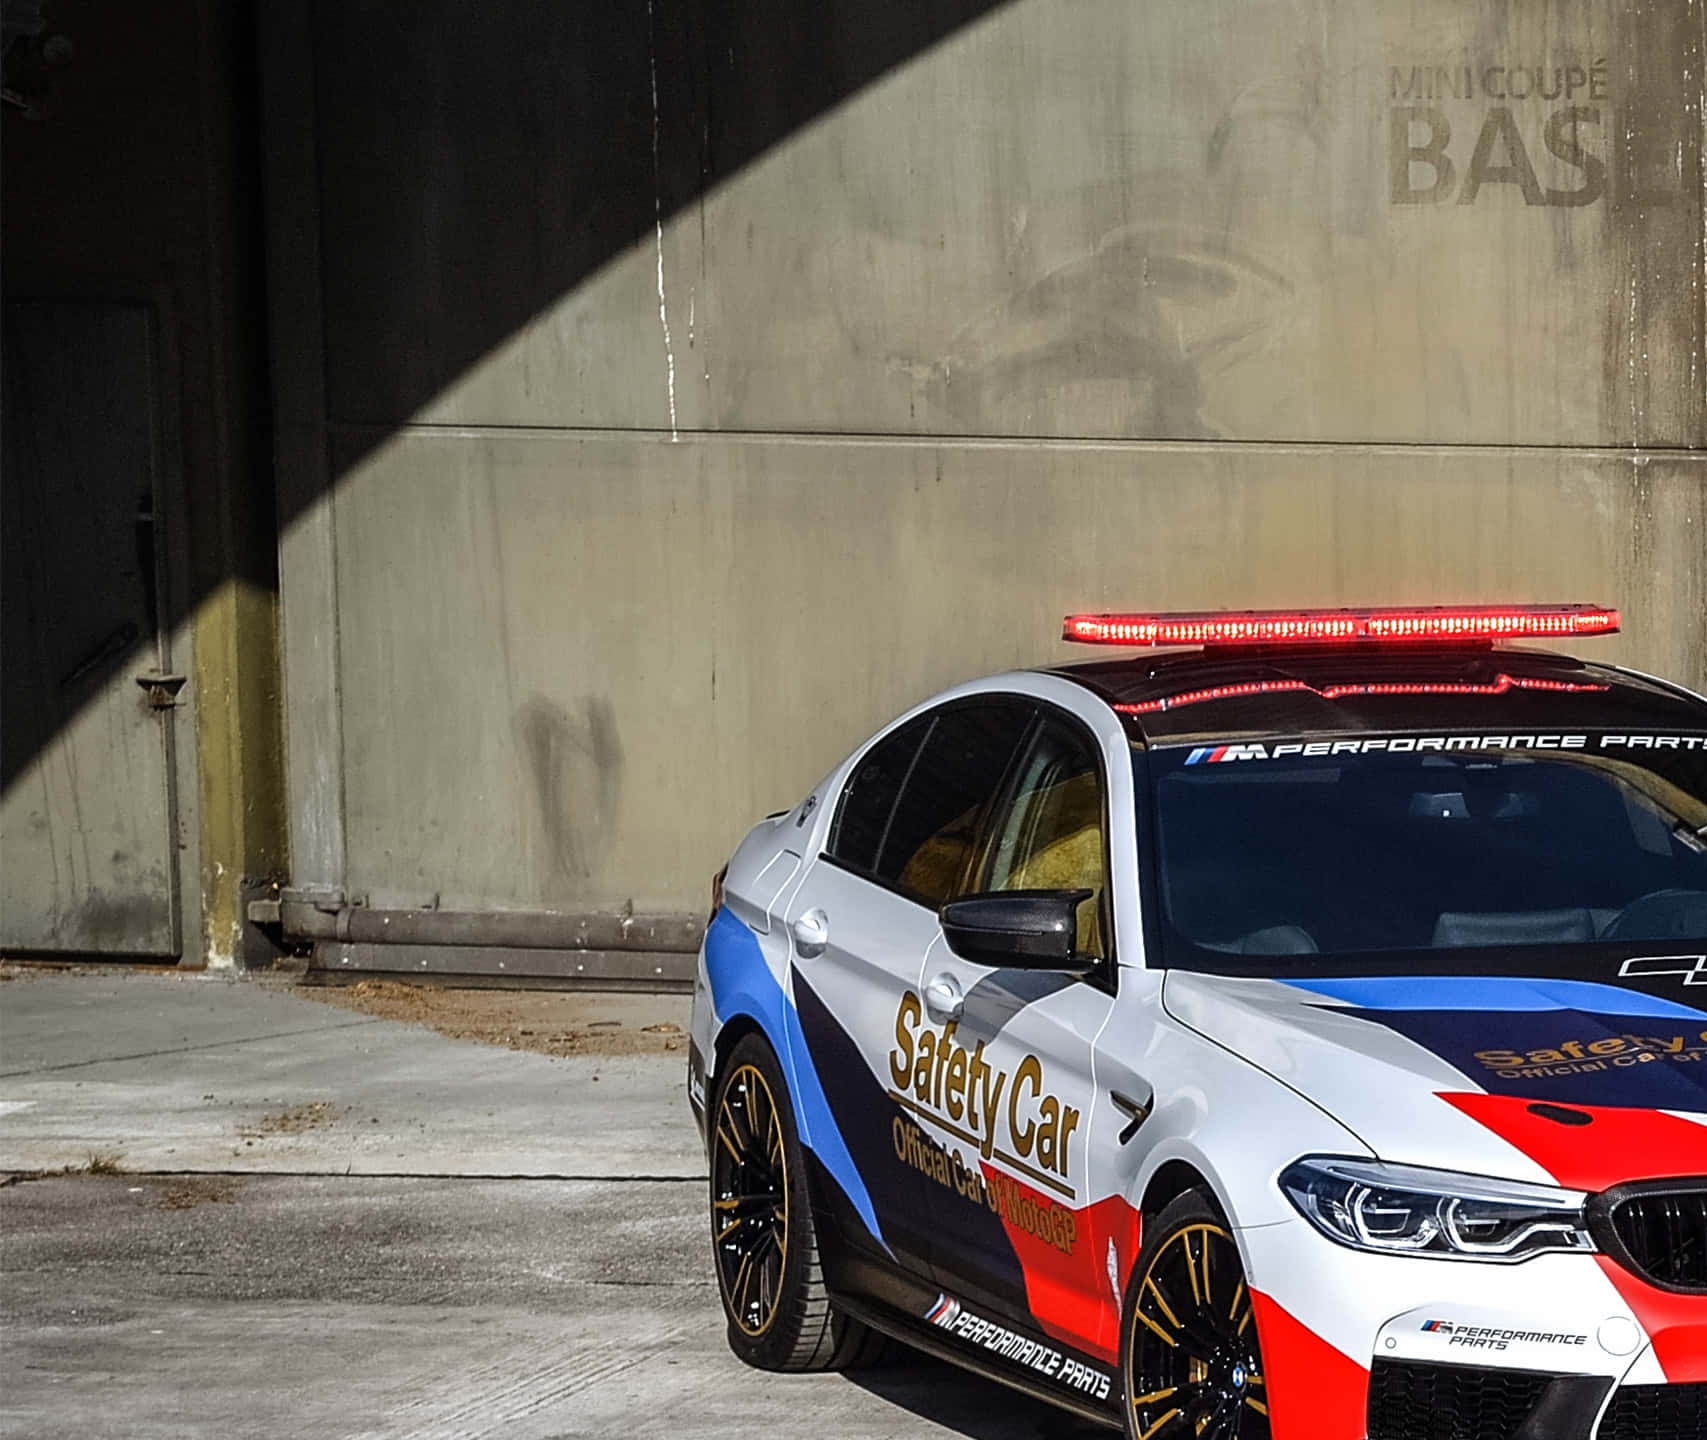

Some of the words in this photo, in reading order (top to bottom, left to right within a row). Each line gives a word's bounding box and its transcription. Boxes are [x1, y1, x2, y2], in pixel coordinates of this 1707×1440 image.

[1272, 735, 1586, 758] PERFORMANCE
[1474, 1034, 1684, 1068] Safety
[1496, 1061, 1608, 1079] Official
[1613, 1052, 1665, 1067] Car
[1673, 1052, 1701, 1062] of
[889, 990, 1007, 1161] Safety
[1008, 1055, 1080, 1178] Car
[893, 1116, 951, 1188] Official
[952, 1148, 983, 1205] Car
[985, 1171, 1005, 1218] of
[1004, 1175, 1078, 1256] MotoGP
[1449, 1336, 1510, 1350] PARTS
[1454, 1325, 1588, 1345] PERFORMANCE
[949, 1311, 1062, 1376] PERFORMANCE
[1057, 1358, 1111, 1400] PARTS
